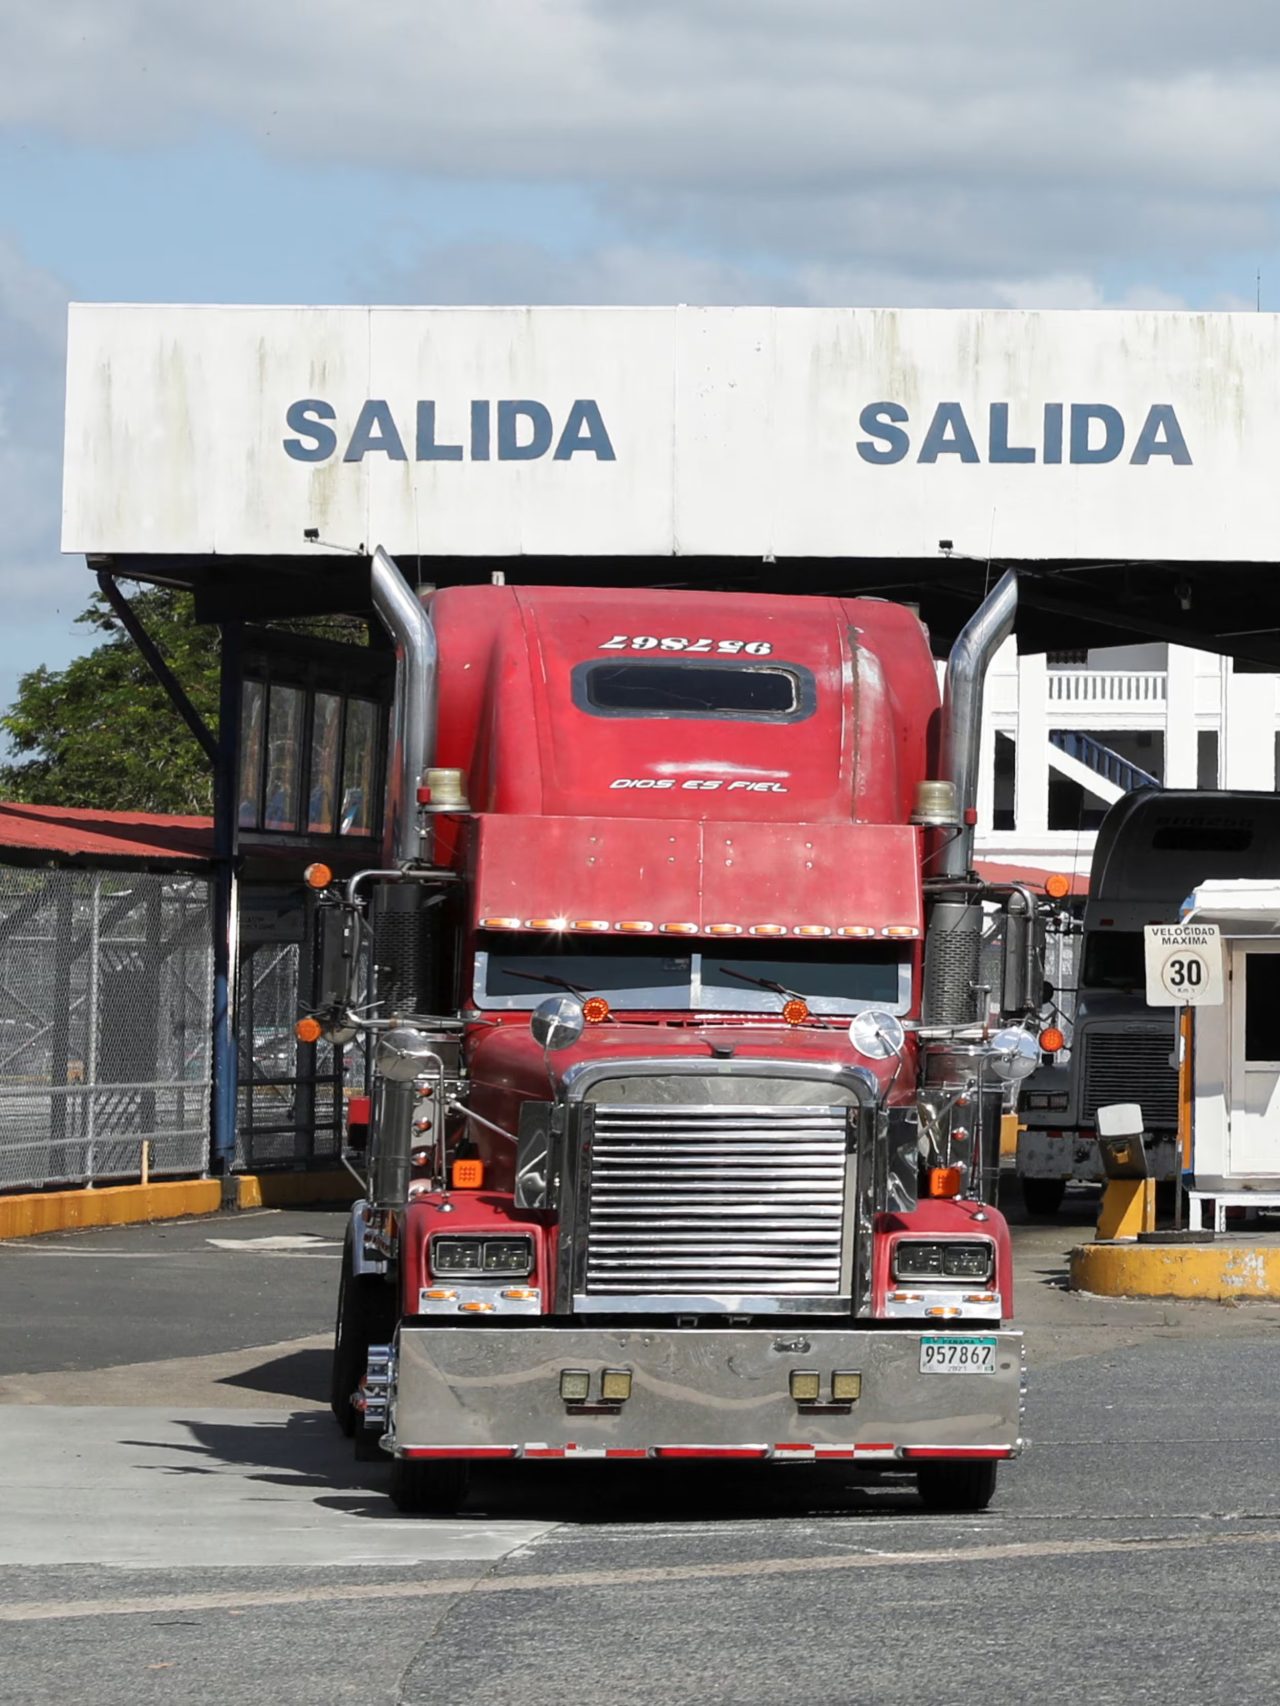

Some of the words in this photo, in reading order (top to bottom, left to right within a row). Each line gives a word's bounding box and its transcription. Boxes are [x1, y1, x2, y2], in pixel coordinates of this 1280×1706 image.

[283, 399, 617, 464] SALIDA
[857, 402, 1191, 466] SALIDA
[609, 778, 676, 791] DIOS
[681, 779, 724, 792] ES
[727, 781, 791, 794] FIEL
[1152, 927, 1215, 936] VELOCIDAD
[1162, 937, 1208, 945] MAXIMA
[1170, 960, 1202, 986] 30
[926, 1346, 991, 1364] 957867
